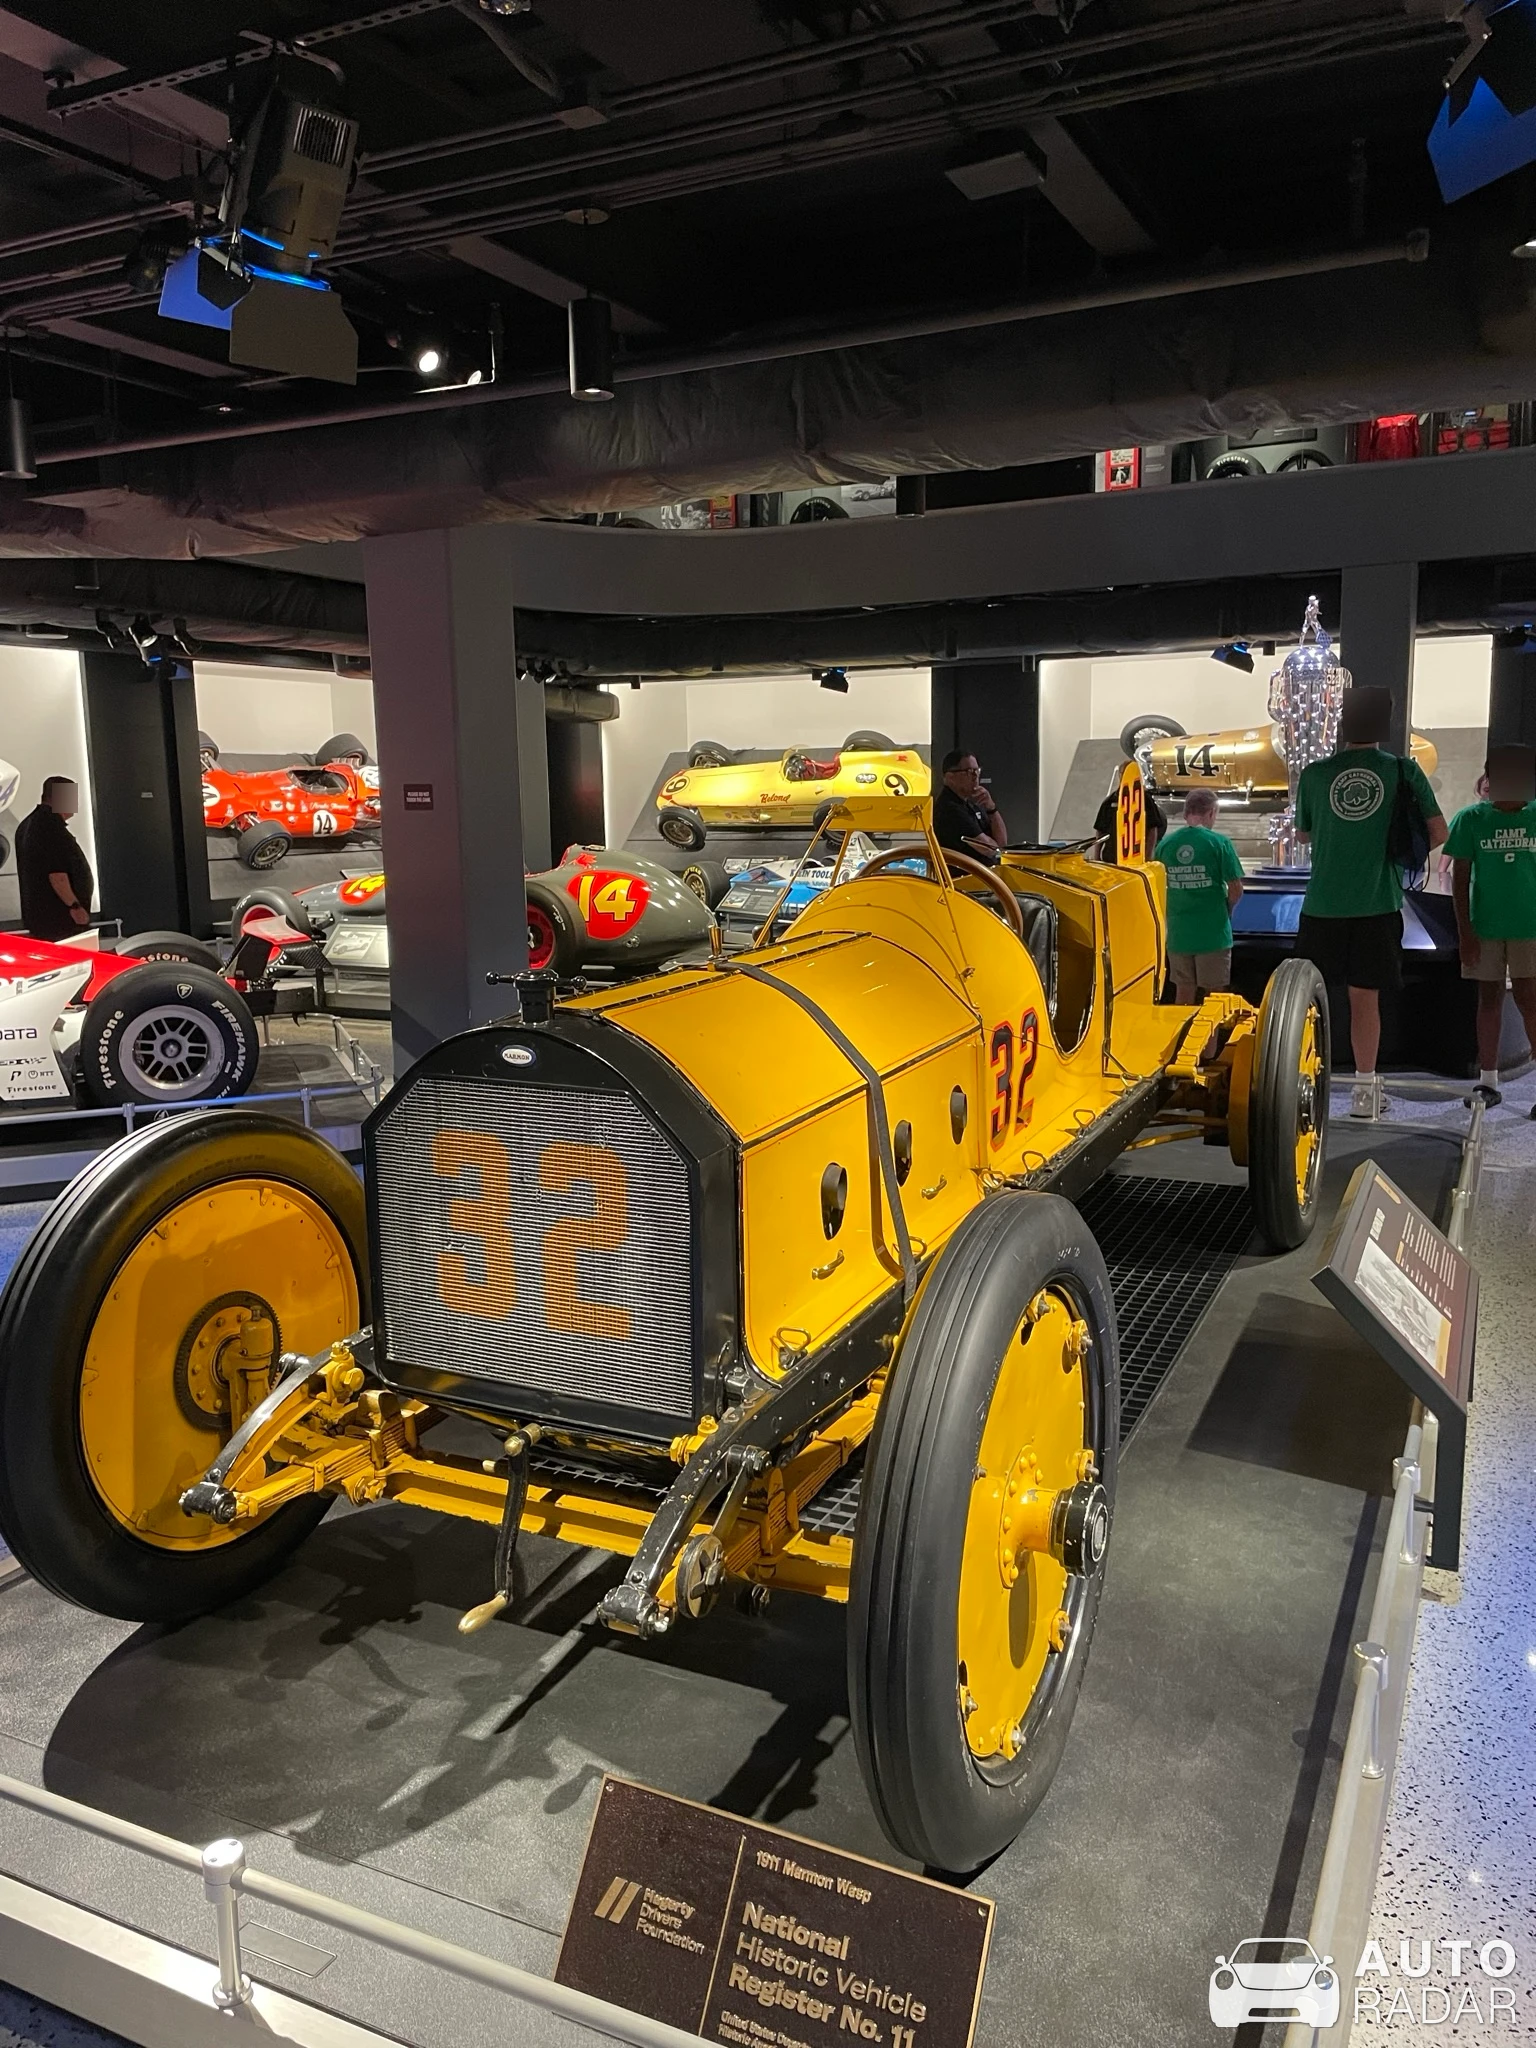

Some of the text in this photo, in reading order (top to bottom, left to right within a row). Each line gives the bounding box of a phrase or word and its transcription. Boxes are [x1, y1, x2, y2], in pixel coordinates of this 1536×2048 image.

[1216, 455, 1249, 466] Firestone
[1174, 744, 1220, 777] 14
[883, 773, 909, 797] 9
[314, 814, 333, 835] 14
[1121, 776, 1143, 861] 32
[1495, 828, 1527, 840] CAMP
[577, 874, 637, 923] 14
[98, 1009, 125, 1090] Firestone
[211, 1000, 247, 1083] FIREHAWK
[504, 1052, 532, 1062] MARMON
[6, 1084, 57, 1094] Firestone
[990, 1006, 1039, 1153] 32
[431, 1129, 634, 1342] 32
[756, 1850, 872, 1905] 1911 Marmon Wasp
[640, 1902, 683, 1930] Drivers
[643, 1887, 696, 1920] Hagerty
[636, 1917, 705, 1955] Foundation
[742, 1901, 851, 1961] National
[735, 1931, 928, 2024] Historic Vehicle
[721, 2009, 750, 2032] United
[728, 1962, 916, 2048] Register No. 11
